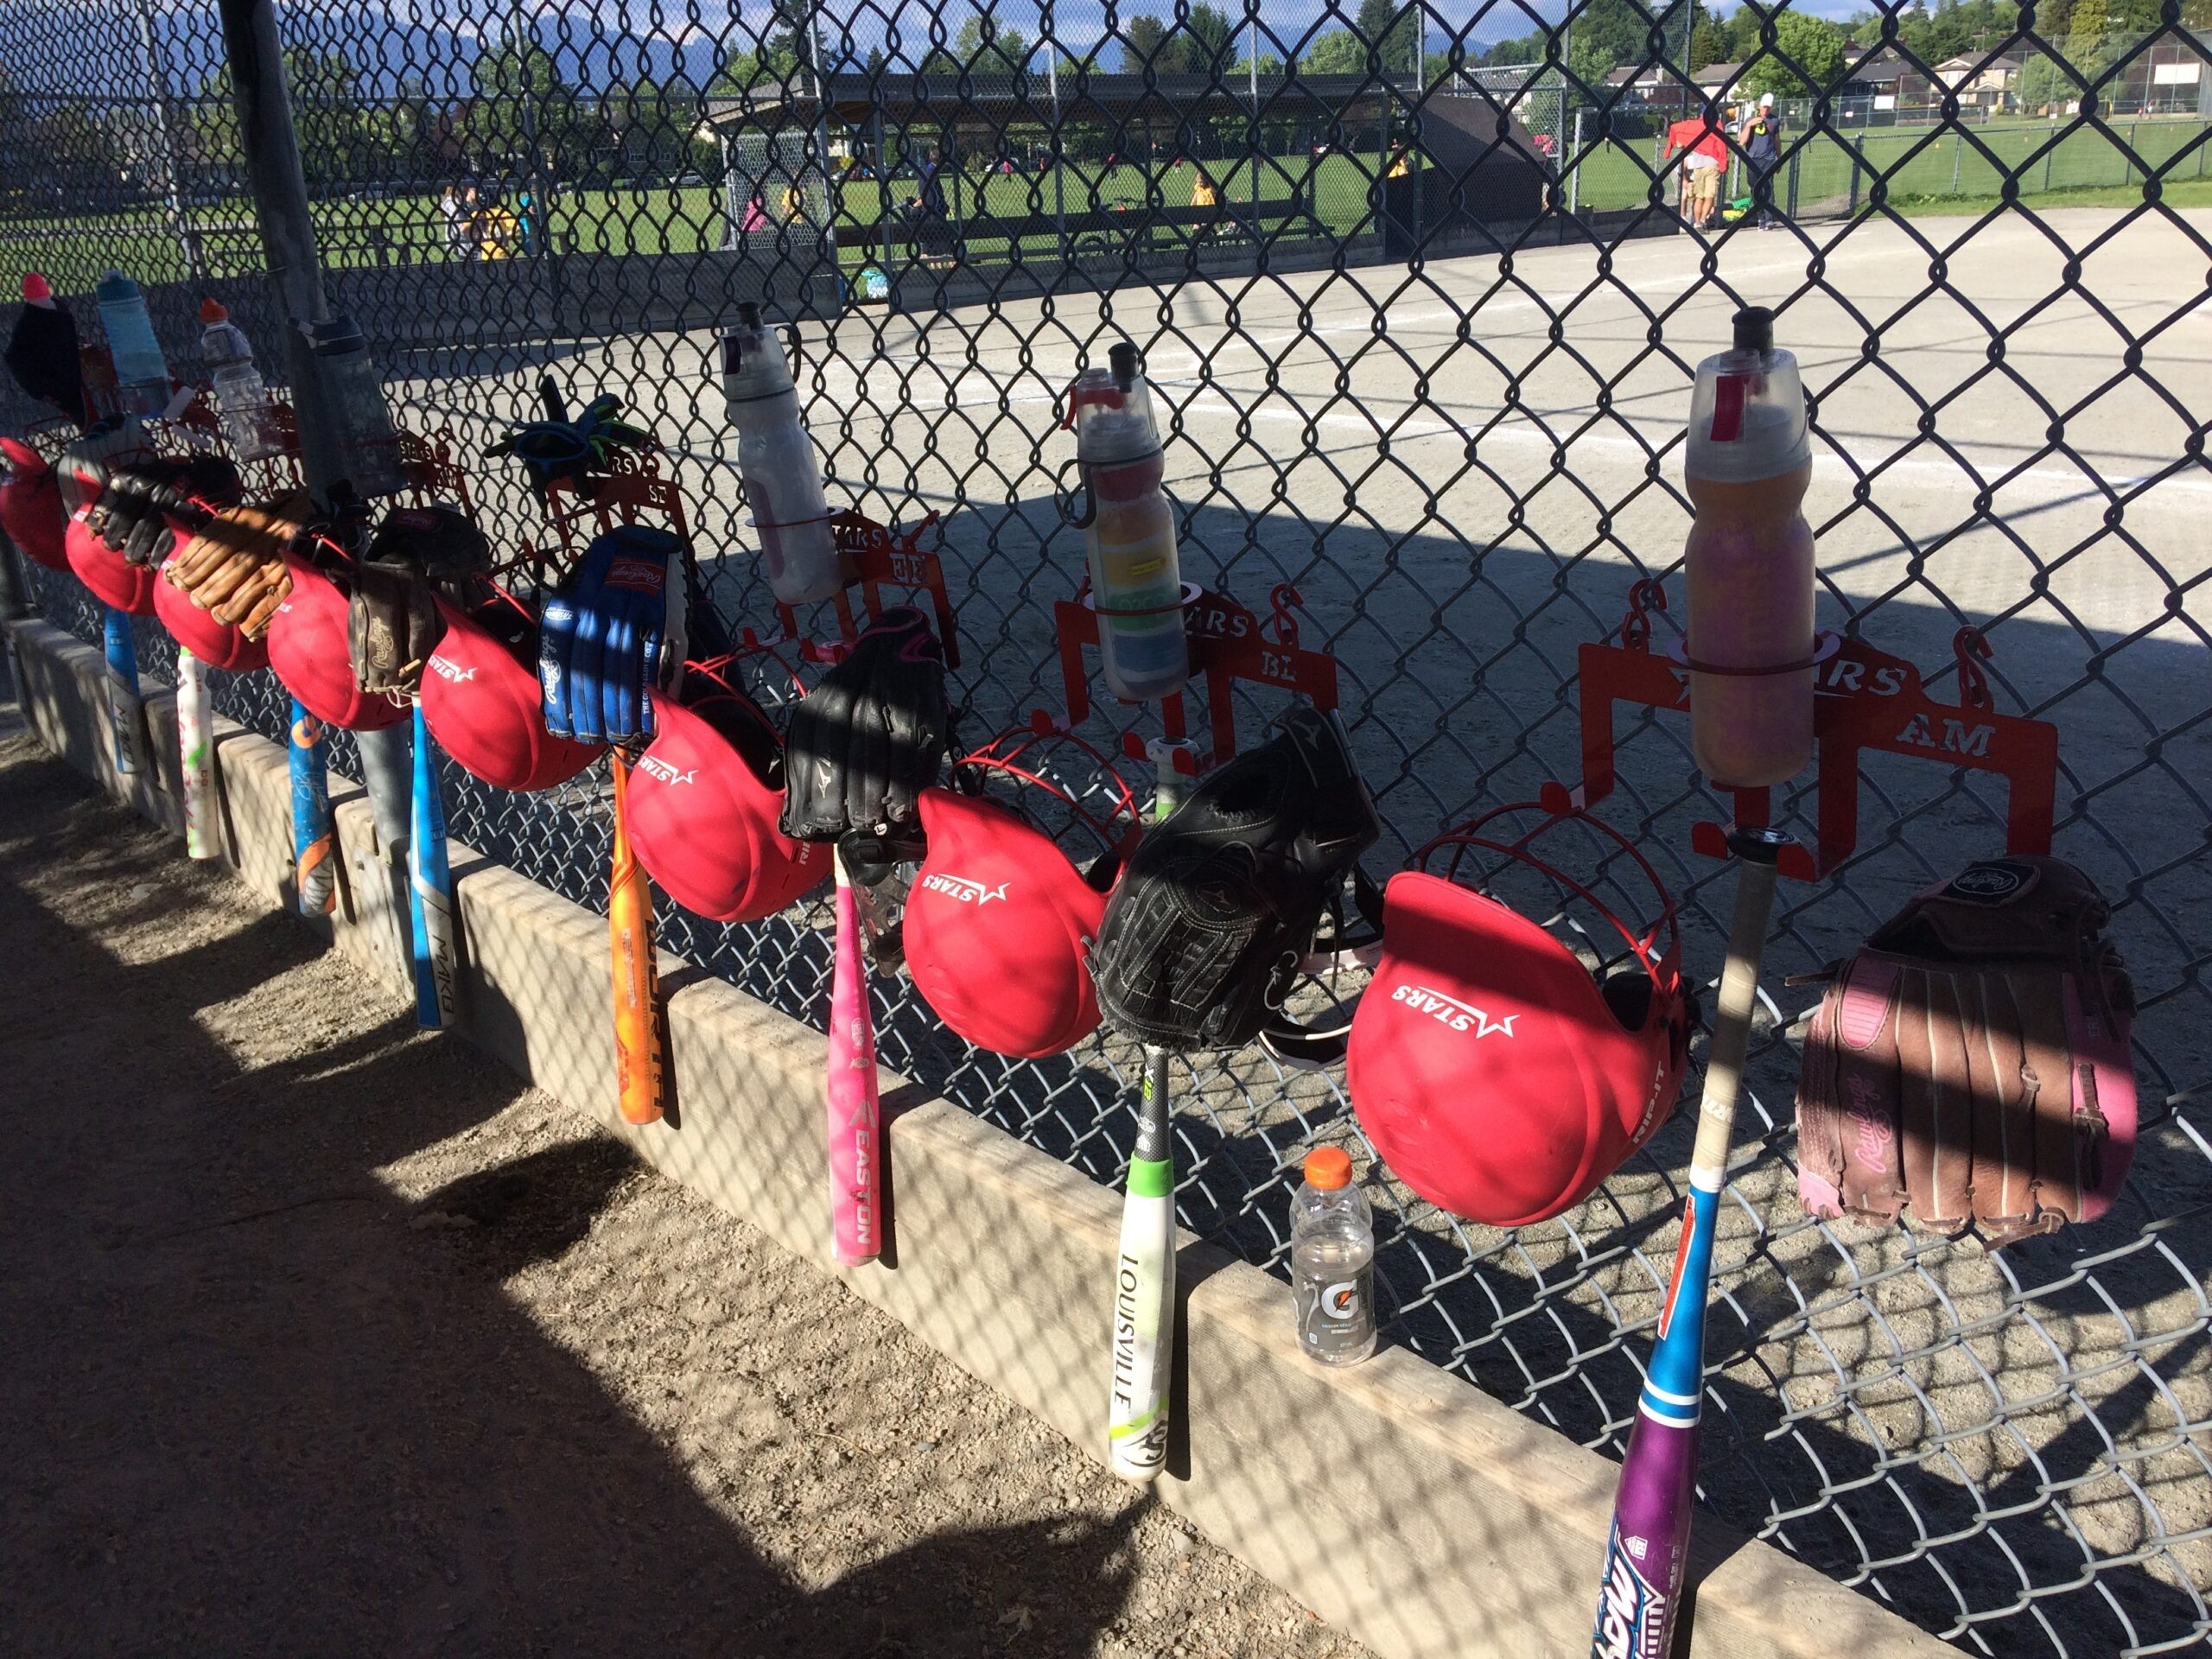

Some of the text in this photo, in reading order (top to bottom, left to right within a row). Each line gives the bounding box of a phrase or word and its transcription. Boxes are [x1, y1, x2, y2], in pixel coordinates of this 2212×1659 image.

[831, 524, 882, 550] TARS
[1185, 607, 1249, 638] ARS
[428, 654, 455, 679] STAR
[1894, 713, 1997, 759] AM
[921, 874, 979, 903] STARS
[432, 937, 454, 1014] MAKO
[1390, 984, 1477, 1033] STARS
[1631, 1060, 1666, 1145] RIP-IT
[1847, 1074, 1893, 1174] Rawlings
[852, 1129, 872, 1244] EASTON
[1113, 1253, 1139, 1408] LOUISVILLE
